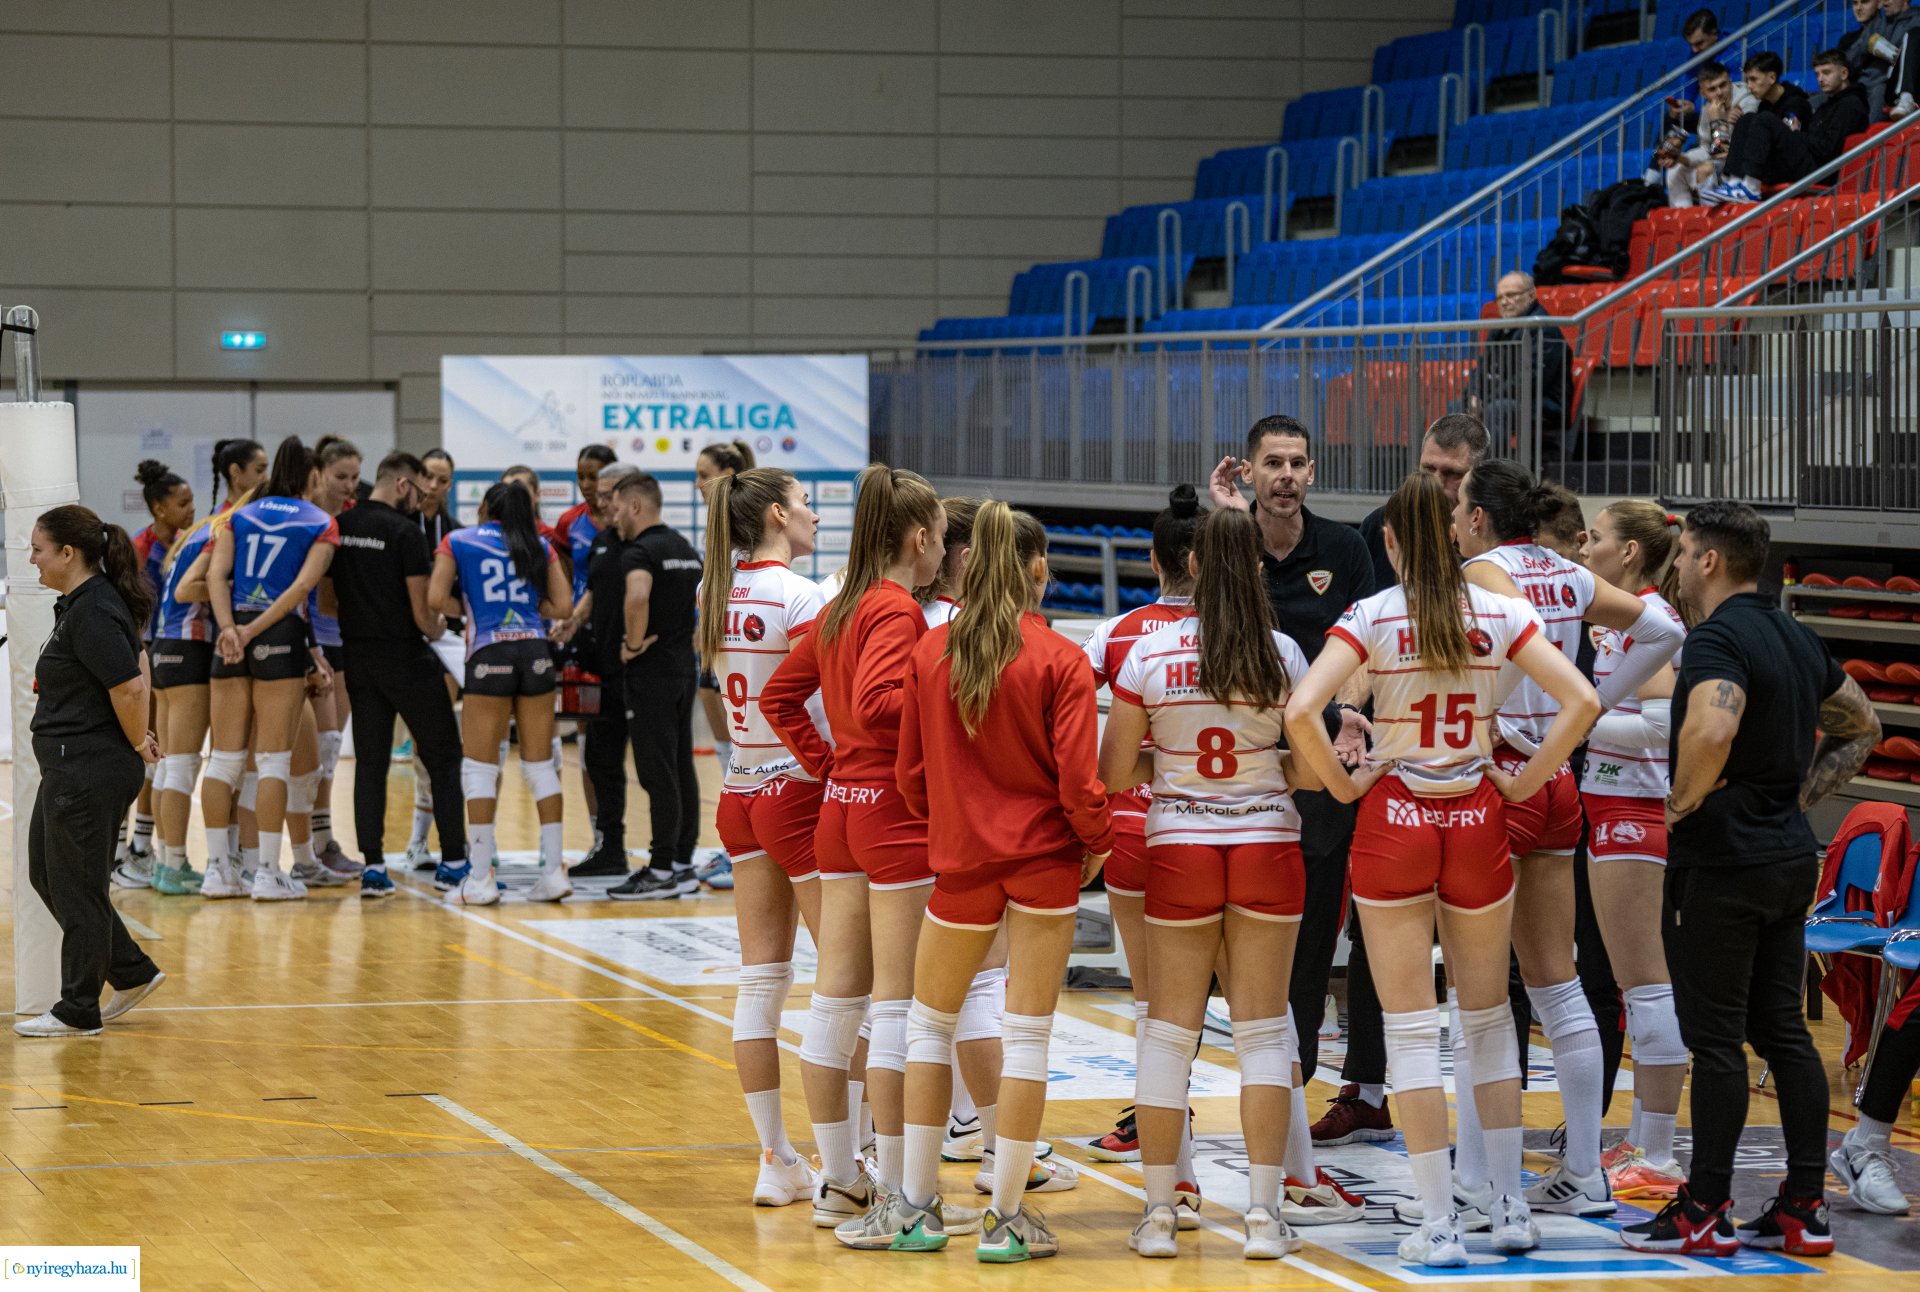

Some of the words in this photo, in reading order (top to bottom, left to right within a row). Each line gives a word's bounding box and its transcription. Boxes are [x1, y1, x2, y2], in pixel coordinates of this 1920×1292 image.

[604, 404, 796, 430] EXTRALIGA
[246, 533, 287, 578] 17
[481, 558, 529, 604] 22
[727, 672, 747, 724] 9
[1410, 693, 1477, 749] 15
[1196, 726, 1238, 779] 8
[1597, 762, 1623, 776] ZHK
[1175, 801, 1240, 815] Miskolc
[1421, 806, 1487, 828] BELFRY
